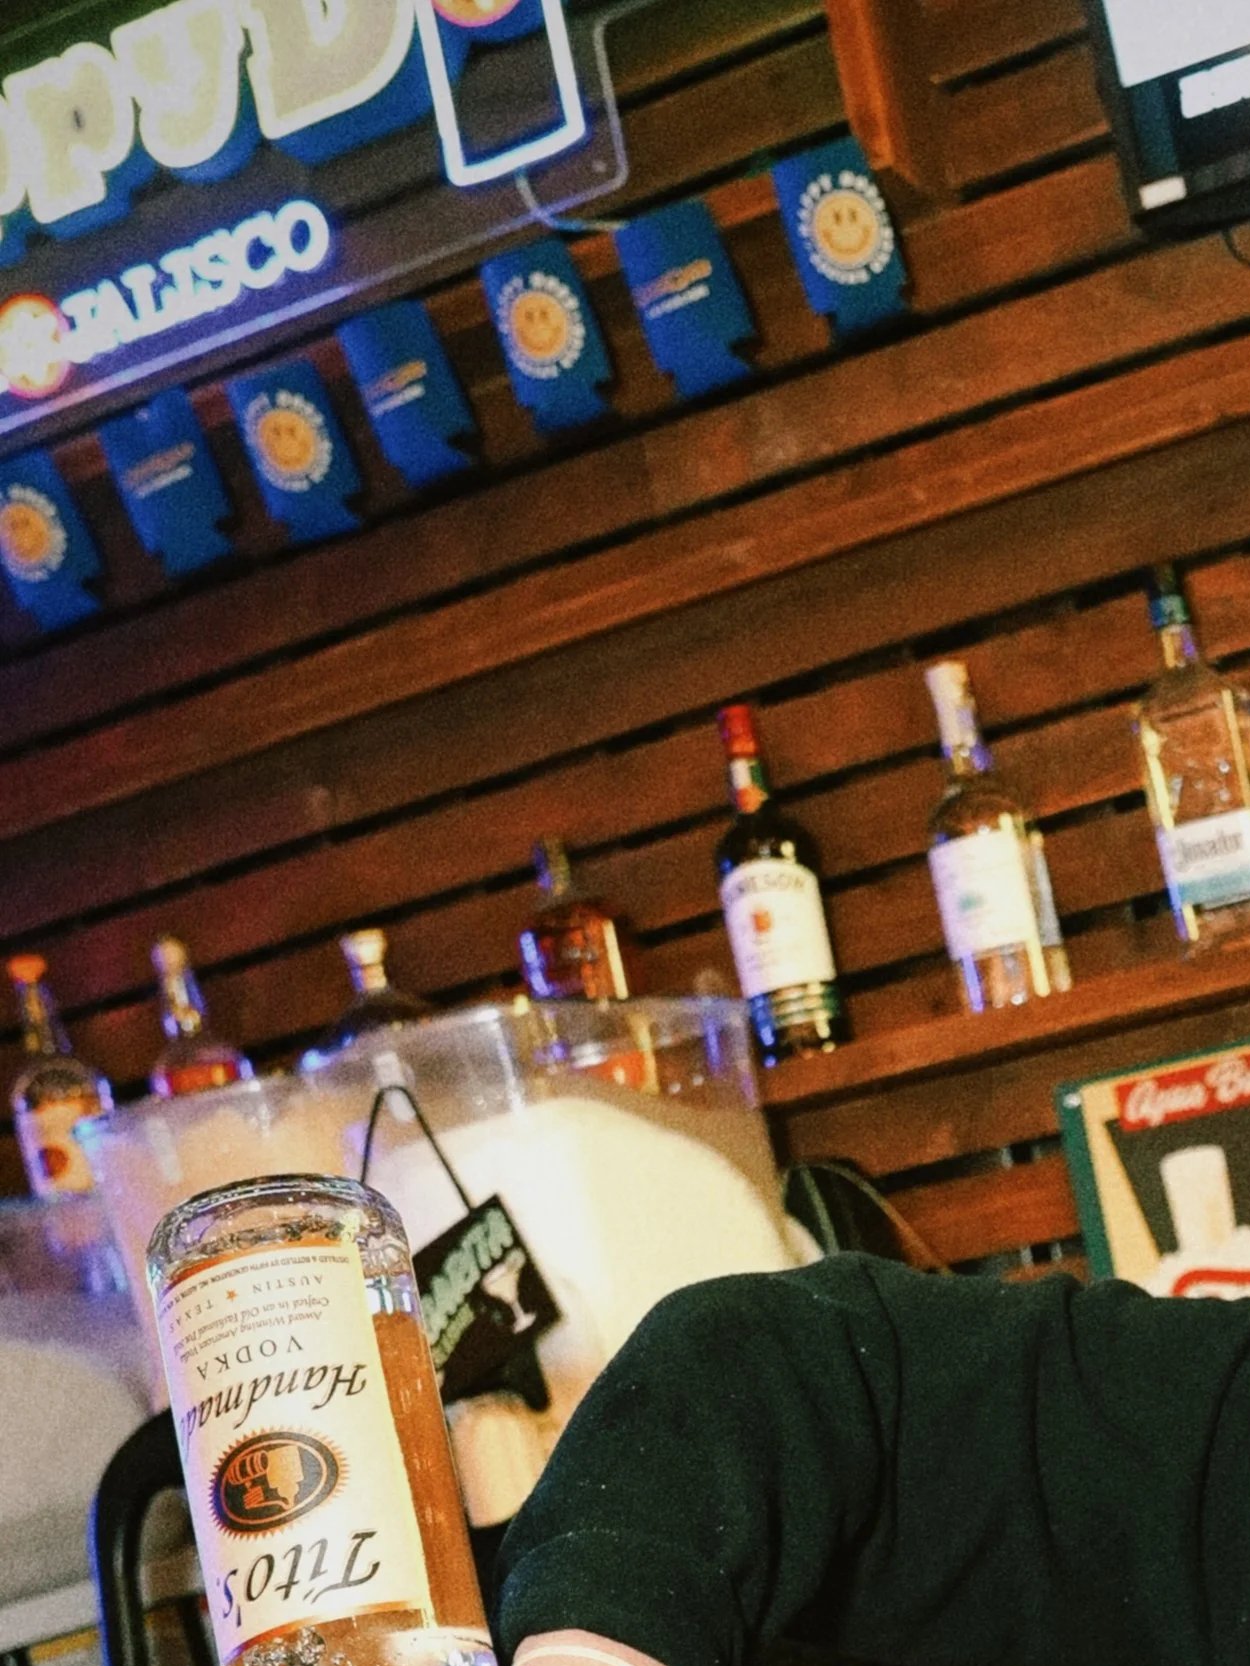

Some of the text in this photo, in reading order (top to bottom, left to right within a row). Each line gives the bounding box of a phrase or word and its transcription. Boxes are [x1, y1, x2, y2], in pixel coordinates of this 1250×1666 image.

[252, 1274, 324, 1294] AUSTIN
[170, 1300, 214, 1333] TEXAS
[239, 1317, 287, 1333] Winning
[288, 1311, 323, 1324] Award
[200, 1327, 239, 1350] American
[196, 1335, 304, 1380] VODKA
